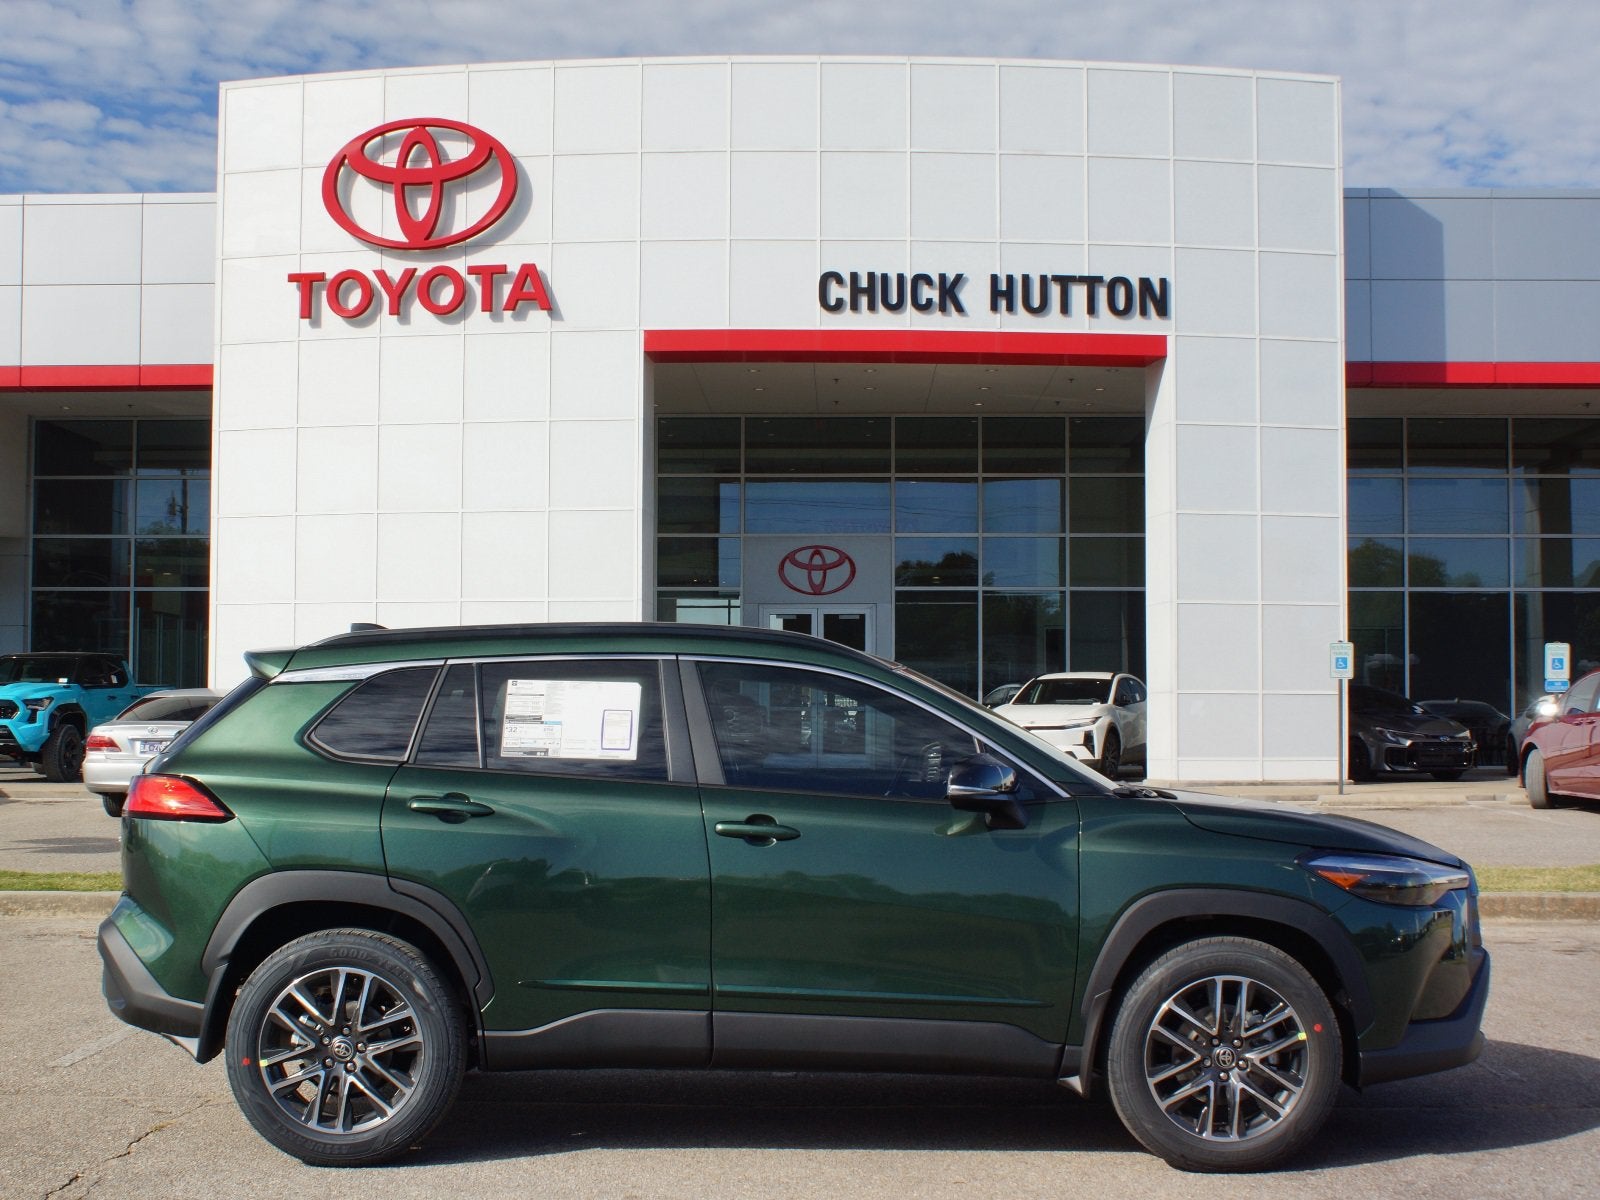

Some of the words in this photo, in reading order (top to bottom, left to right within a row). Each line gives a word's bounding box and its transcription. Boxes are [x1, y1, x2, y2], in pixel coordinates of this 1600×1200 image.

[288, 263, 553, 319] TOYOTA
[819, 271, 964, 313] CHUCK
[991, 273, 1168, 316] HUTTON
